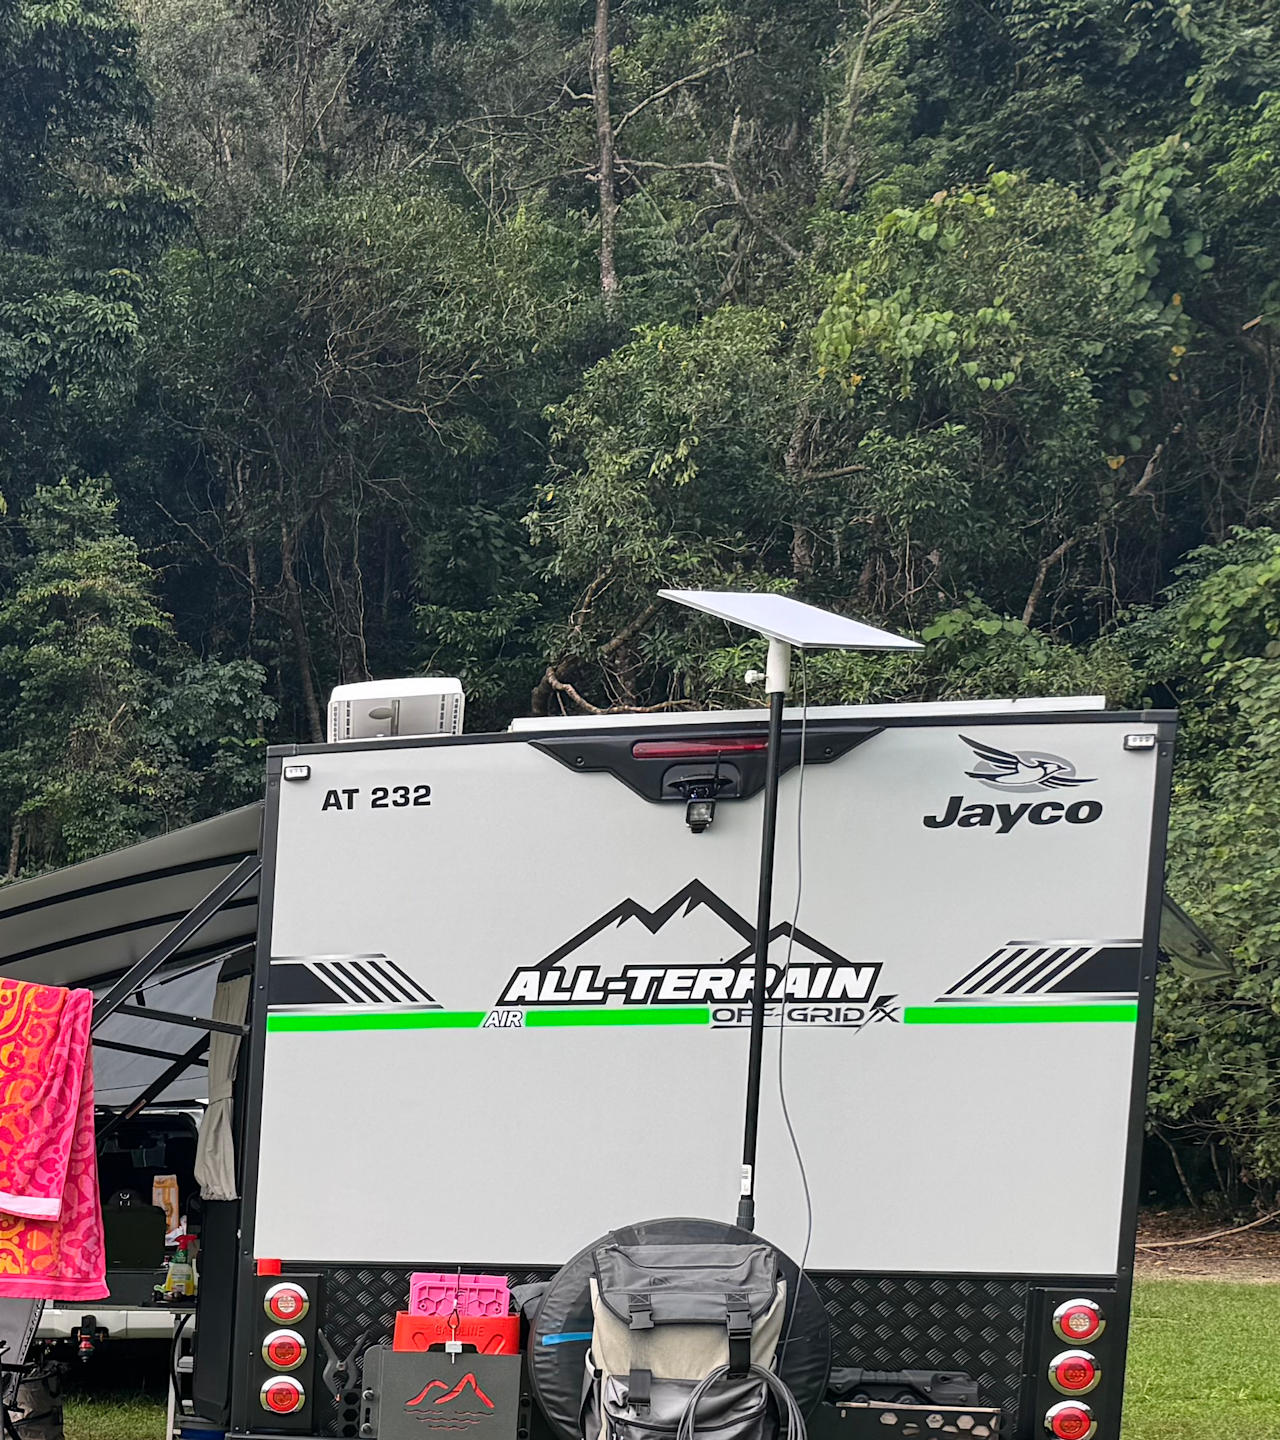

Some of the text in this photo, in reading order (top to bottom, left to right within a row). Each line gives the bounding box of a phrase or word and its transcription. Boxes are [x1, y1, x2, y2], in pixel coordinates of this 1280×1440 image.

[321, 784, 432, 811] AT 232
[922, 795, 1104, 834] Jayco
[500, 964, 880, 1005] ALL-TERRAIN
[483, 1009, 523, 1028] AIR
